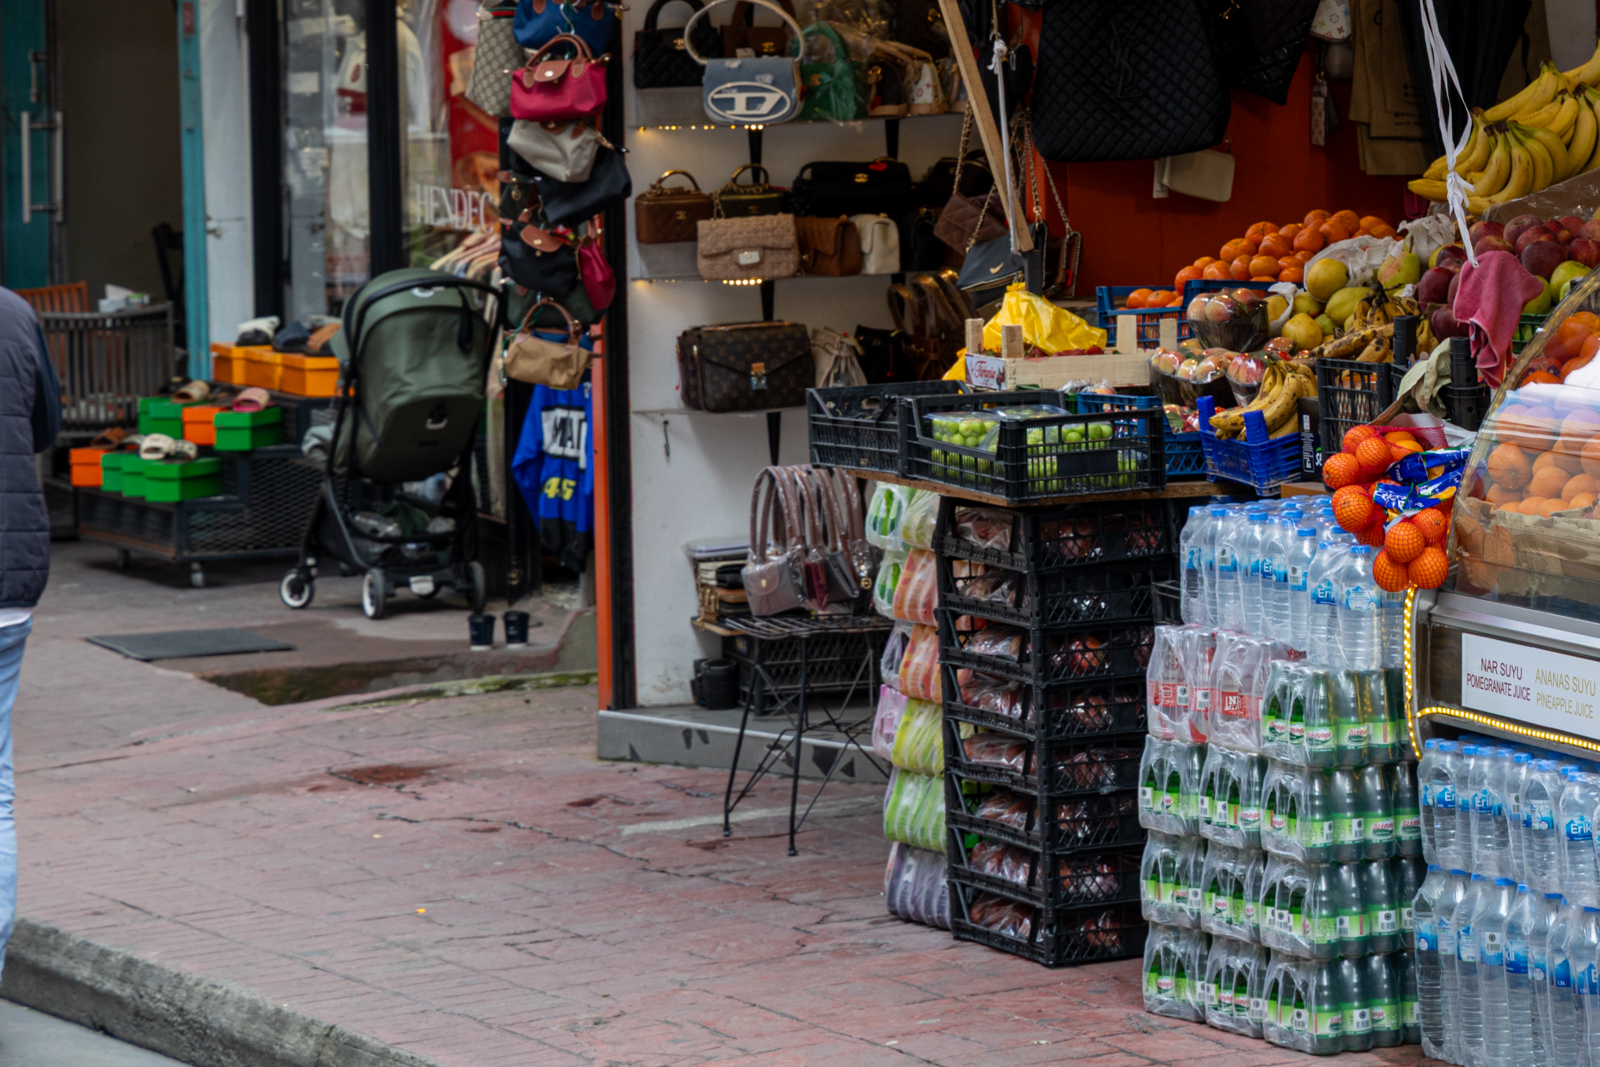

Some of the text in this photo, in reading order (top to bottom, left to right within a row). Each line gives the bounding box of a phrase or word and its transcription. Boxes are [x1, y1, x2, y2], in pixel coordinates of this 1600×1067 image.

[1481, 658, 1523, 681] NAR SUYU
[1466, 673, 1531, 701] POMEGRANATE JUICE
[1535, 668, 1596, 697] ANANAS SUYU
[1573, 701, 1594, 719] JUICE
